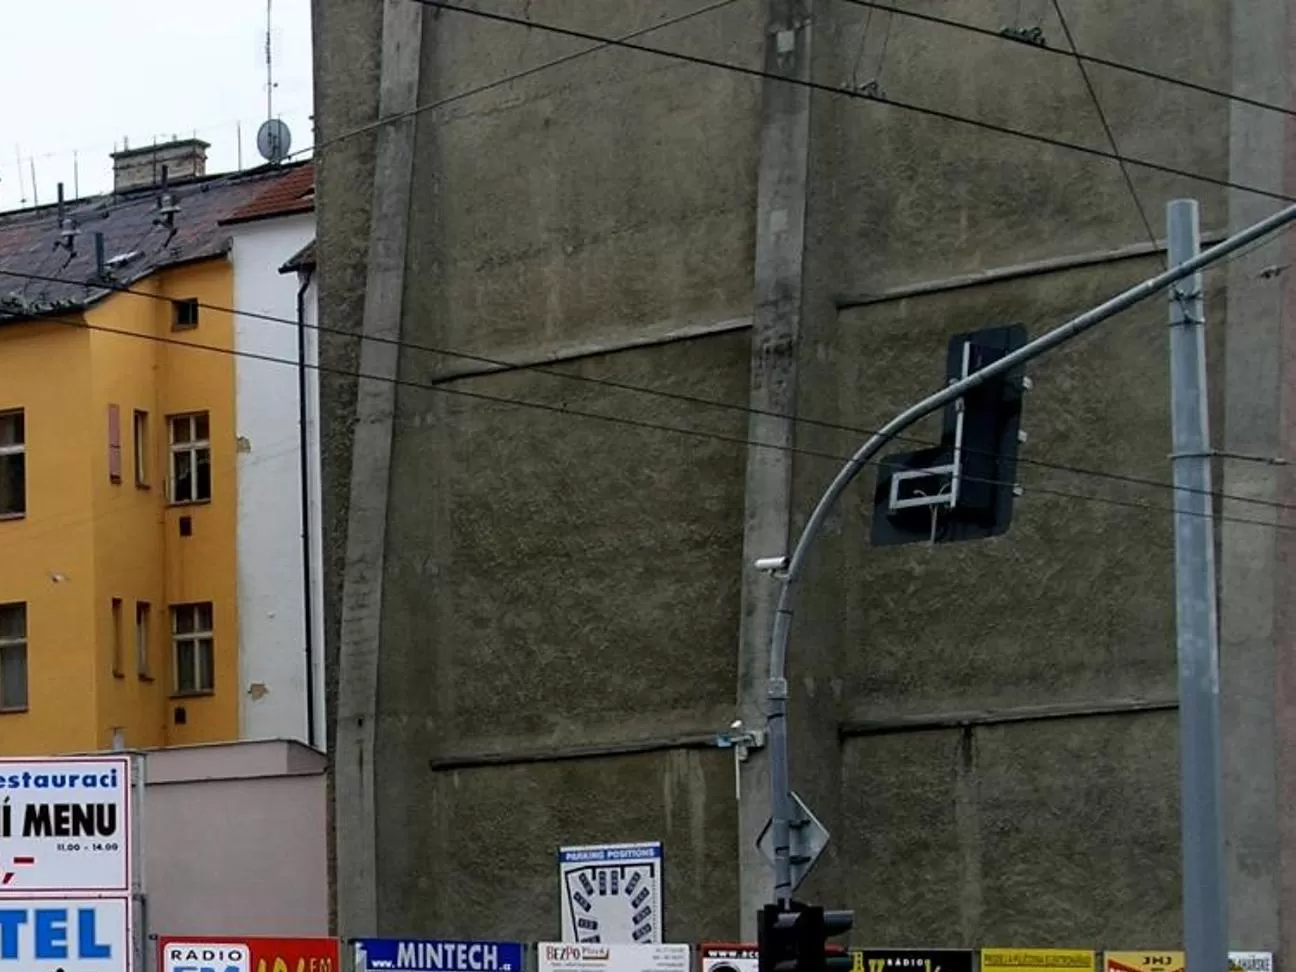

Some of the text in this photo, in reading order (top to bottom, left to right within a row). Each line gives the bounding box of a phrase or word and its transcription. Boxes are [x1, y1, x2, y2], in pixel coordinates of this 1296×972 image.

[22, 803, 117, 837] MENU
[566, 847, 655, 861] PARKING POSITIONS
[171, 949, 243, 961] RADIO
